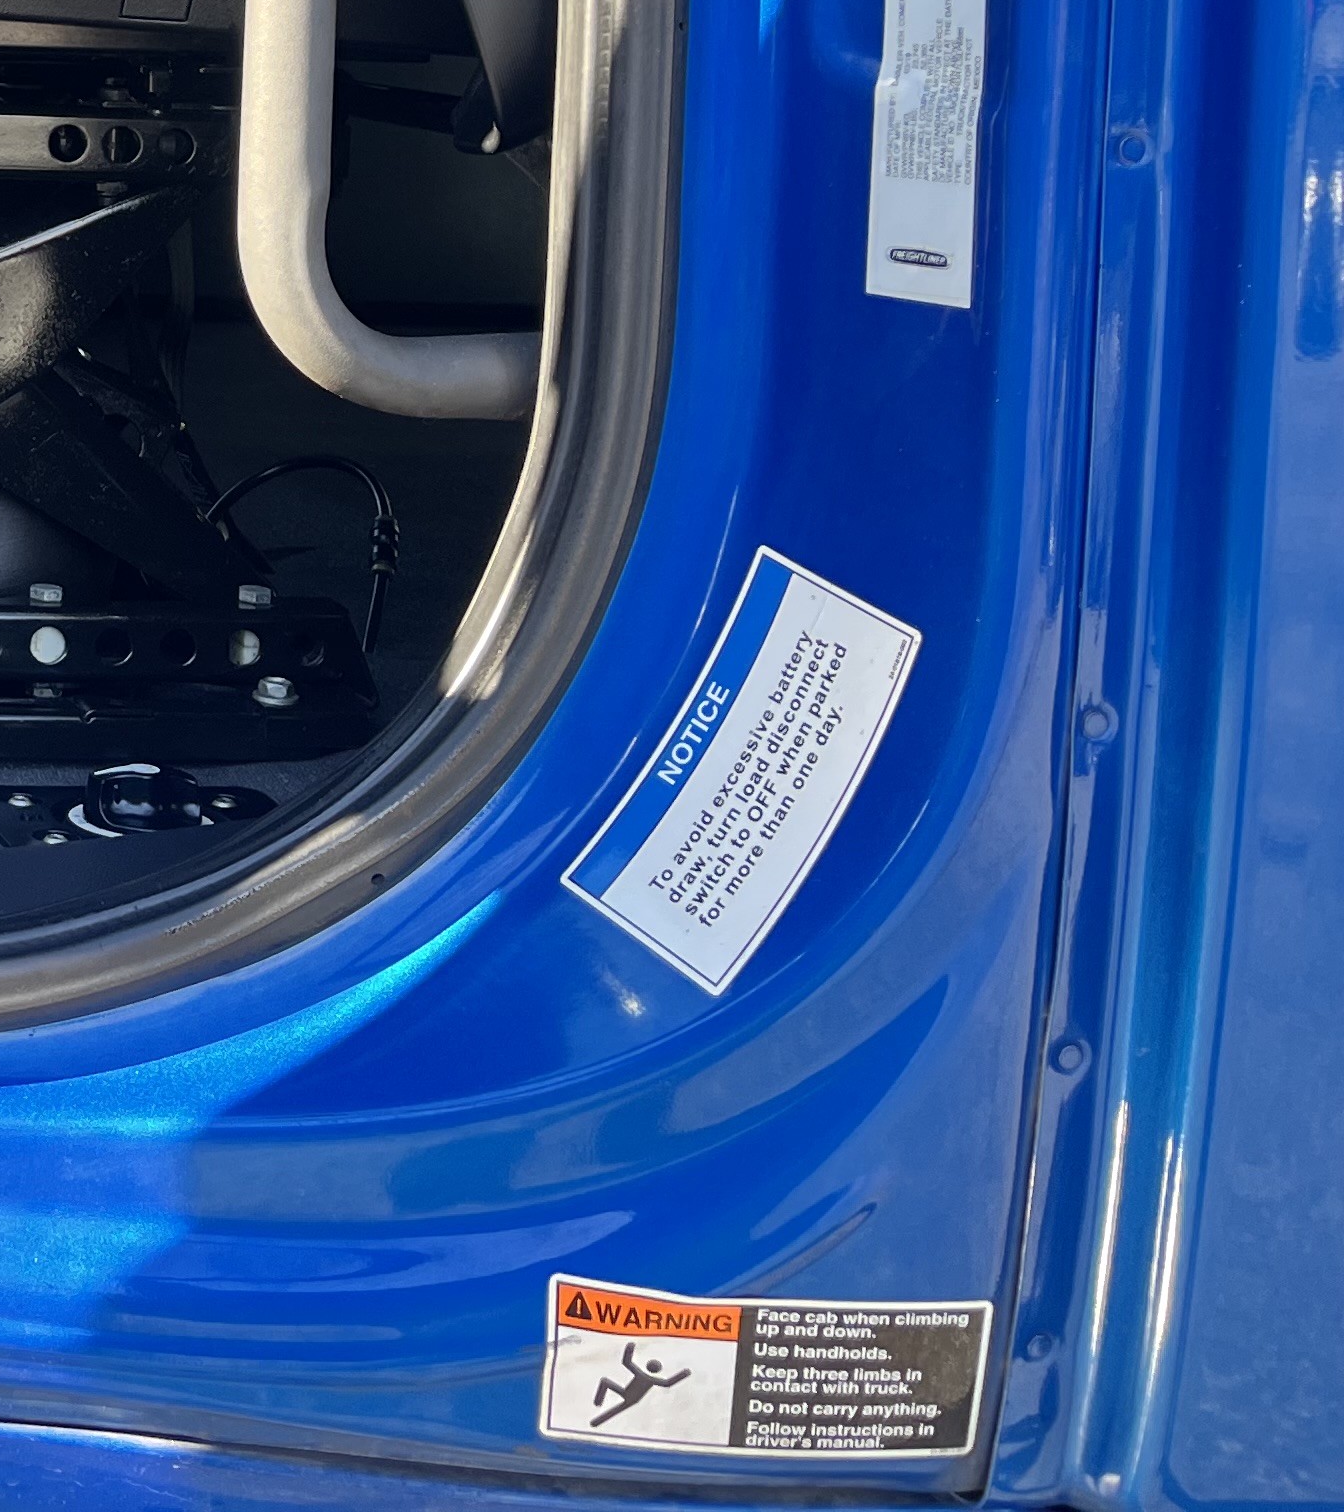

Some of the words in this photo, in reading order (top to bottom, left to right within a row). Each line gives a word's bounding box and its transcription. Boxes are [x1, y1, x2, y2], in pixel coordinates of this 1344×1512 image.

[656, 681, 730, 786] NOTICE
[647, 868, 673, 890] To
[673, 809, 714, 865] avoid
[712, 709, 774, 808] excessive
[768, 629, 813, 705] battery
[669, 855, 713, 904] draw,
[707, 807, 741, 848] turn
[735, 757, 770, 804] load
[766, 639, 829, 754] disconnect
[685, 852, 735, 916] switch
[730, 828, 751, 849] to
[747, 779, 777, 822] OFF
[776, 722, 812, 776] when
[808, 642, 847, 719] parked
[698, 897, 726, 927] for
[724, 845, 765, 896] more
[760, 795, 795, 839] than
[792, 752, 818, 790] one
[815, 706, 843, 746] day.
[596, 1301, 732, 1333] WARNING
[757, 1308, 801, 1323] Face
[805, 1311, 838, 1325] cab
[843, 1311, 890, 1326] when
[895, 1312, 969, 1328] climbing
[756, 1325, 779, 1338] up
[784, 1323, 818, 1338] and
[823, 1324, 877, 1339] down.
[754, 1342, 789, 1357] Use
[794, 1344, 892, 1361] handholds.
[752, 1364, 798, 1382] Keep
[803, 1367, 849, 1381] three
[853, 1368, 901, 1382] limbs
[906, 1368, 922, 1381] in
[750, 1379, 818, 1394] contact
[822, 1381, 860, 1395] with
[864, 1381, 913, 1395] truck.
[748, 1399, 774, 1414] Do
[778, 1402, 808, 1415] not
[813, 1404, 858, 1420] carry
[862, 1403, 942, 1418] anything.
[746, 1421, 806, 1436] Follow
[811, 1423, 913, 1437] instructions
[919, 1423, 934, 1436] in
[745, 1434, 812, 1448] driver's
[817, 1436, 884, 1449] manual.
